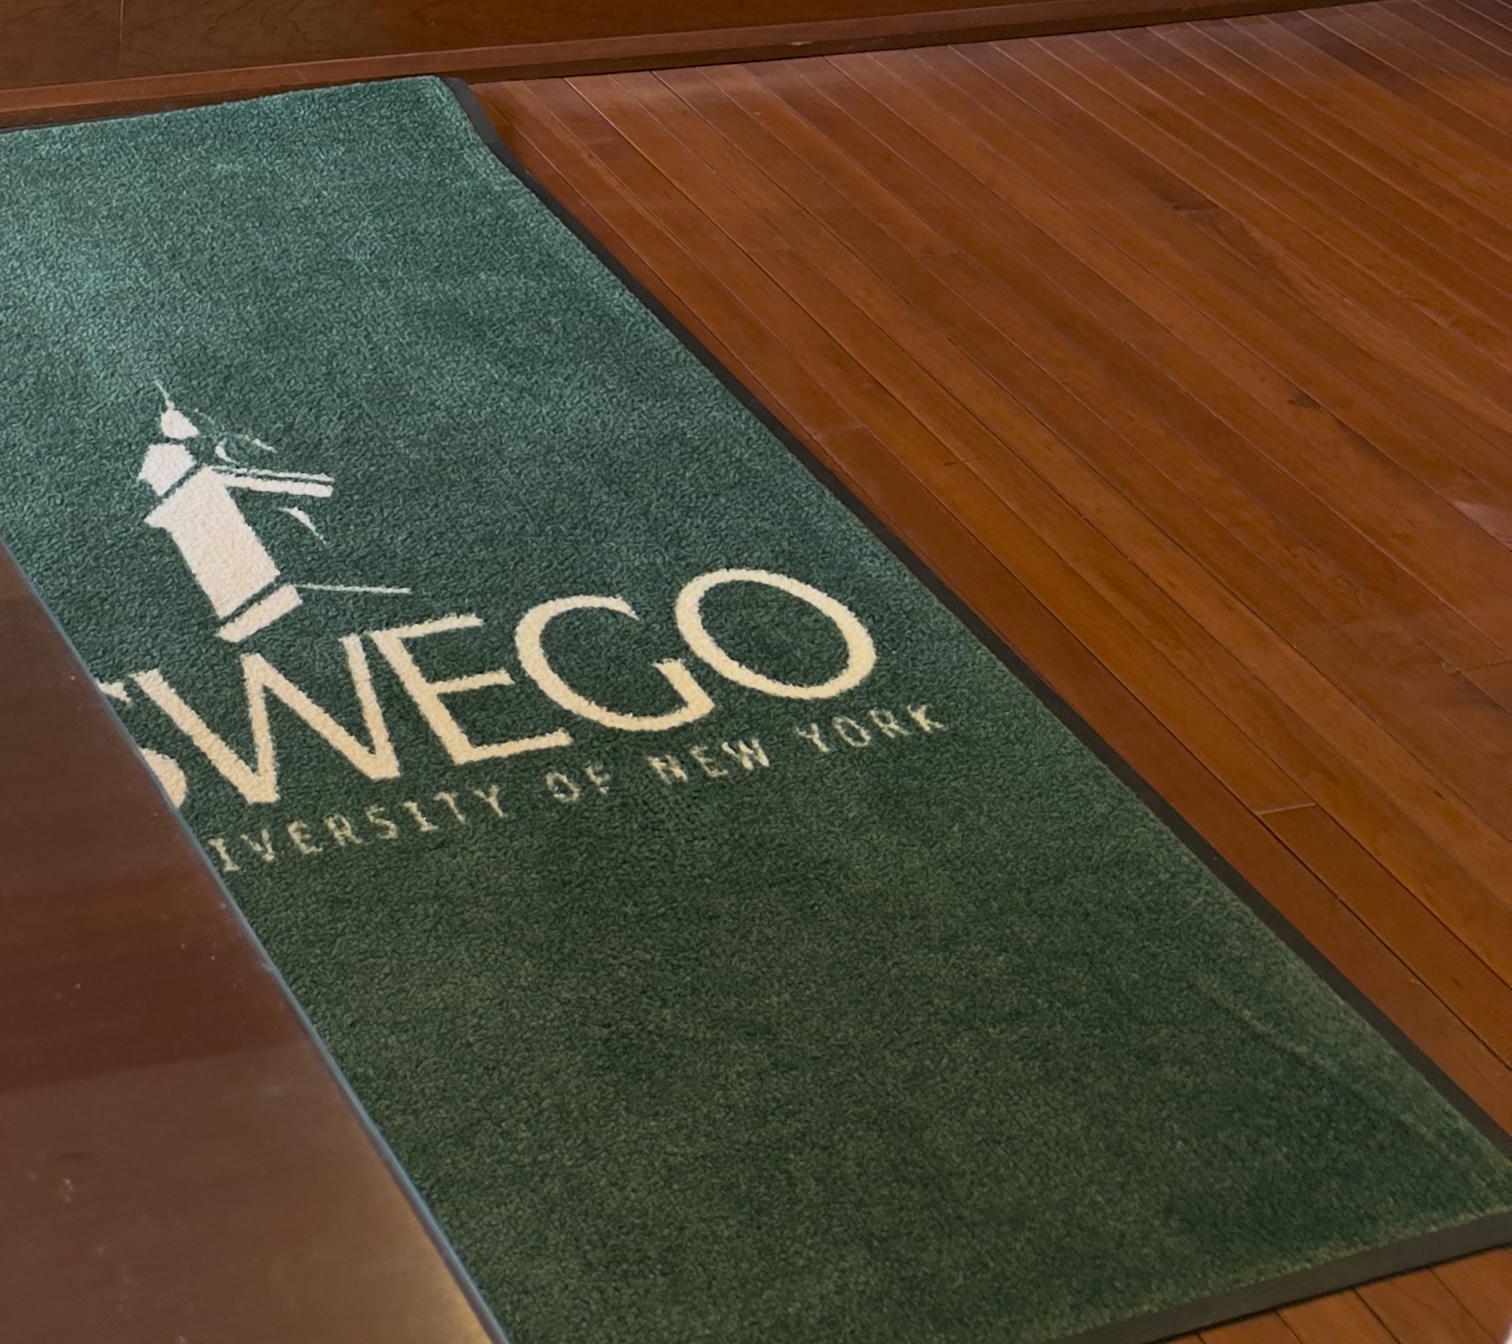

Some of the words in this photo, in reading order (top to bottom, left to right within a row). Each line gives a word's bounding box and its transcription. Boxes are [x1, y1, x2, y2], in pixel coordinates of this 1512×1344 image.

[544, 761, 611, 804] OF
[648, 738, 770, 785] NEW
[795, 704, 945, 753] YORK
